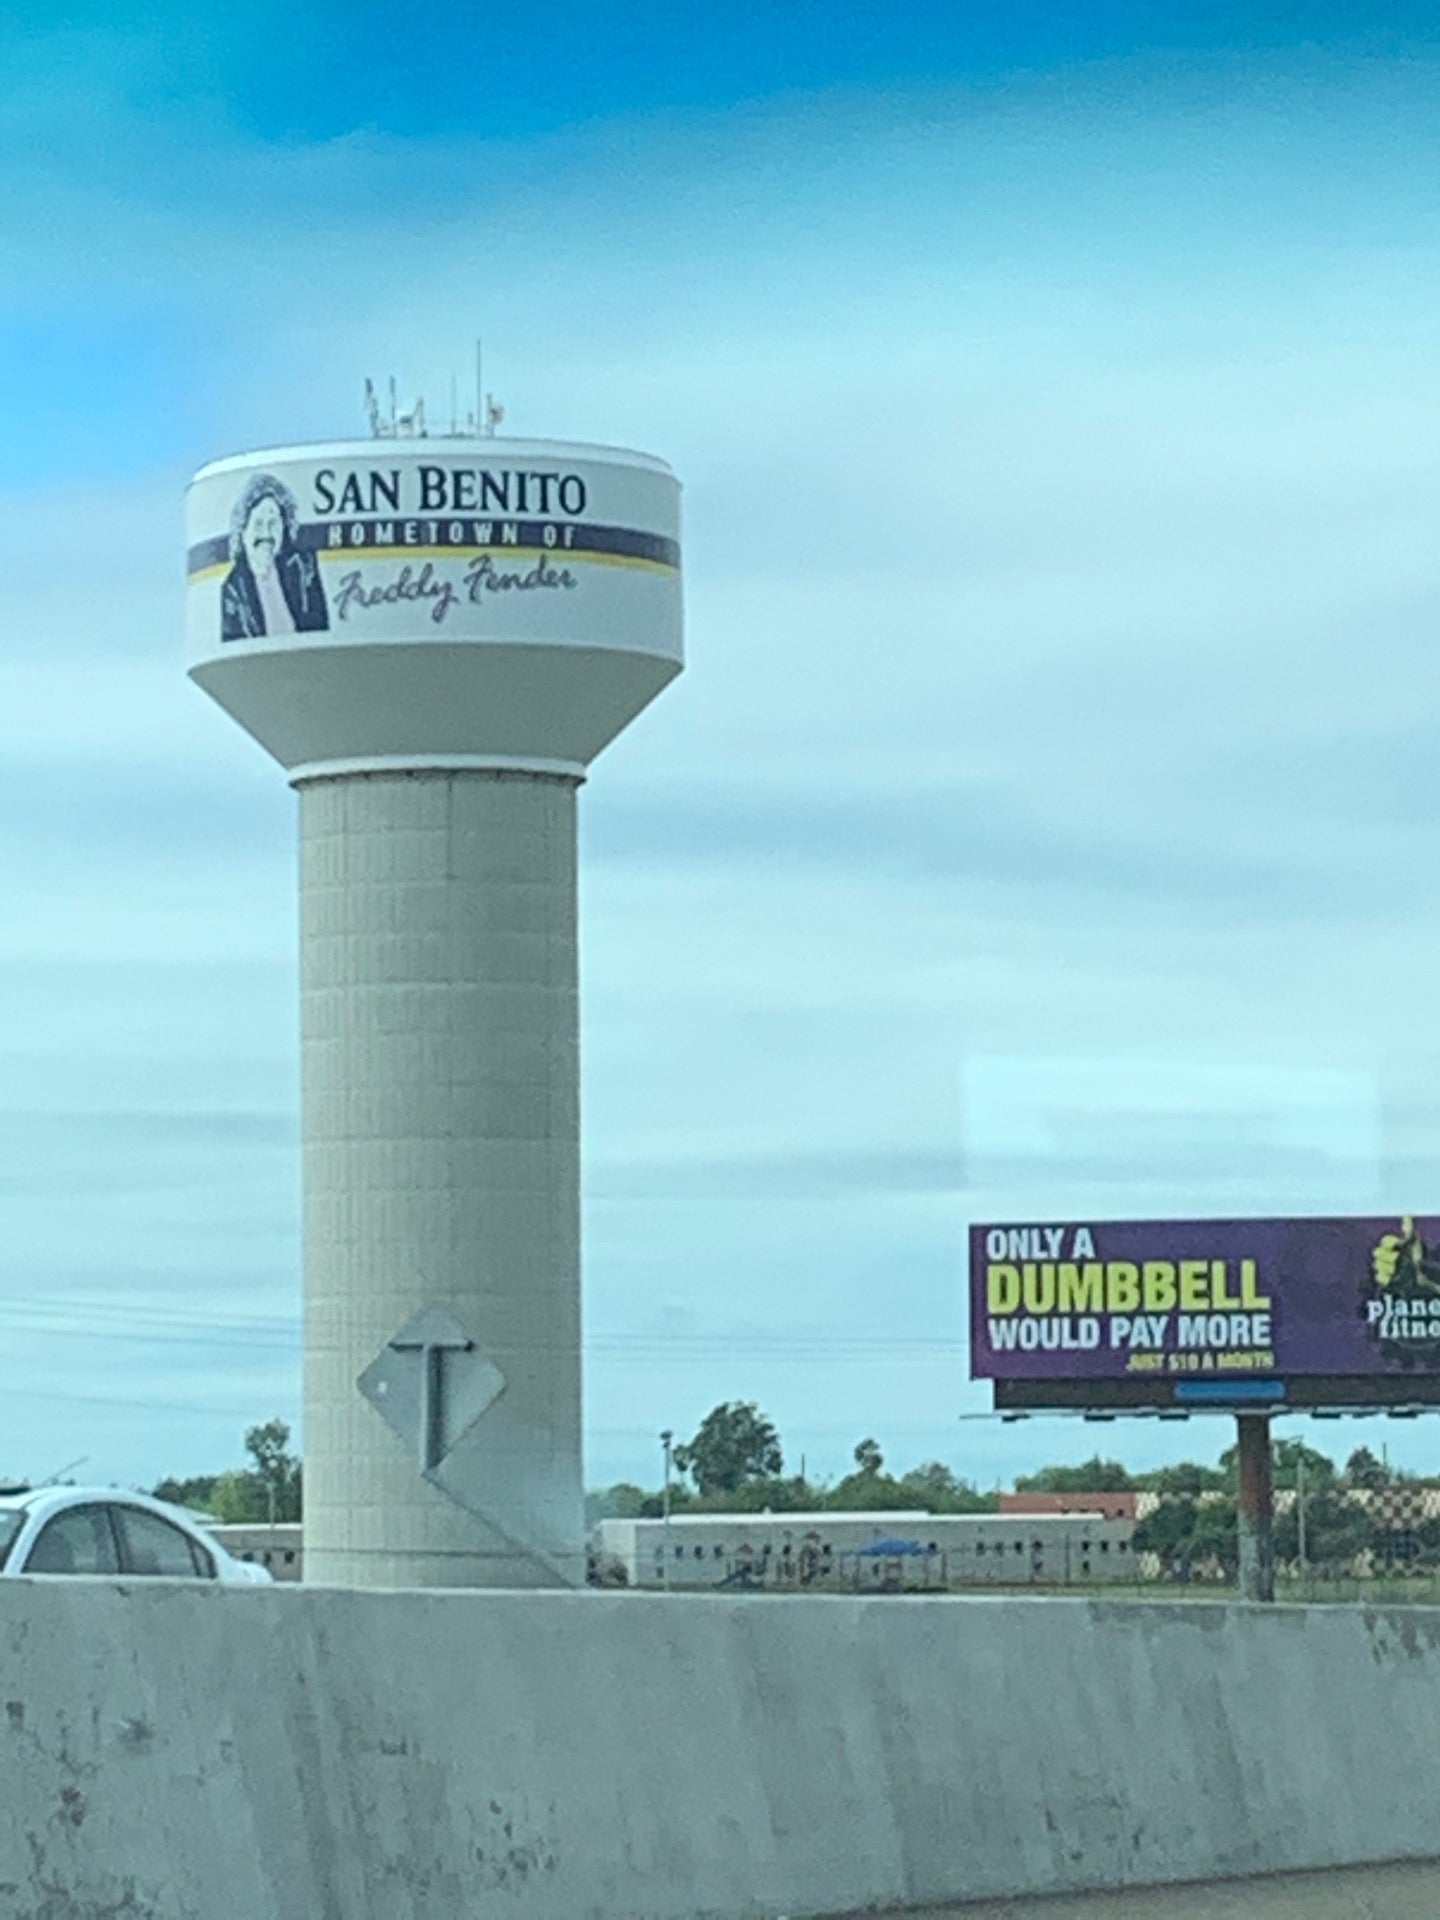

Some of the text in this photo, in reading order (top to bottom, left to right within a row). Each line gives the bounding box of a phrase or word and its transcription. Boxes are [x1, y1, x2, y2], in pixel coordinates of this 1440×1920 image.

[313, 465, 587, 515] SAN BENITO
[328, 521, 576, 547] HOMETOWN OF
[333, 553, 578, 624] Freddy Fender
[986, 1227, 1096, 1260] ONLY A
[987, 1258, 1272, 1314] DUMBBELL
[988, 1313, 1272, 1351] WOULD PAY MORE
[1202, 1352, 1214, 1371] A
